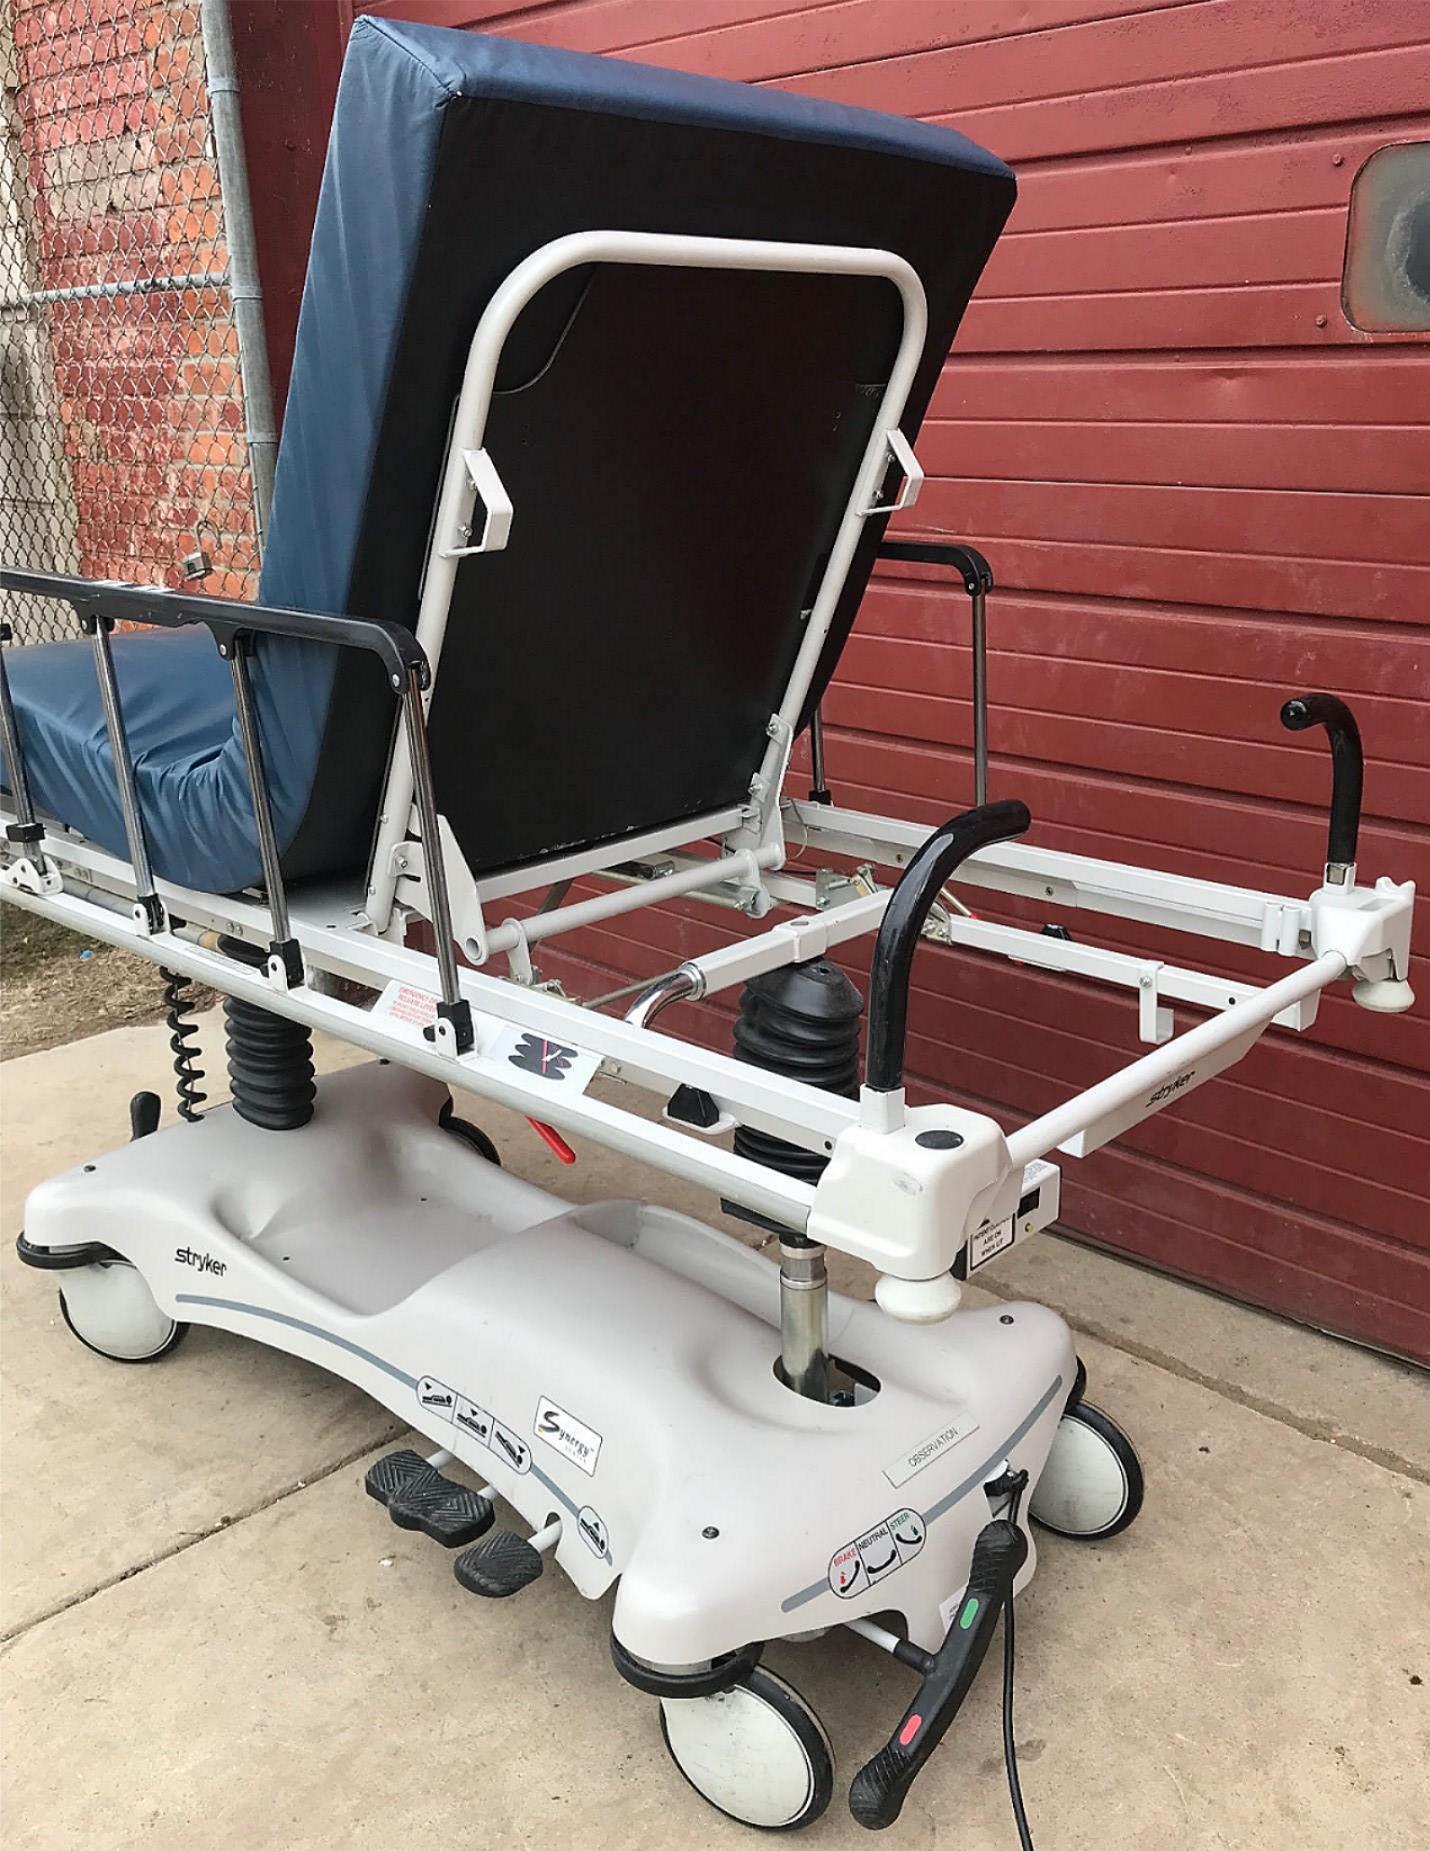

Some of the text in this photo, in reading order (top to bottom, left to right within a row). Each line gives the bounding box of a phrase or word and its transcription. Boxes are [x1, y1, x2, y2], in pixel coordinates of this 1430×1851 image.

[1145, 1070, 1196, 1108] stryker
[174, 1246, 227, 1277] stryker
[538, 1411, 590, 1458] Synergy
[908, 1426, 960, 1468] OBSERVATION
[833, 1512, 910, 1567] BRAKE NEUTRAL STEER
